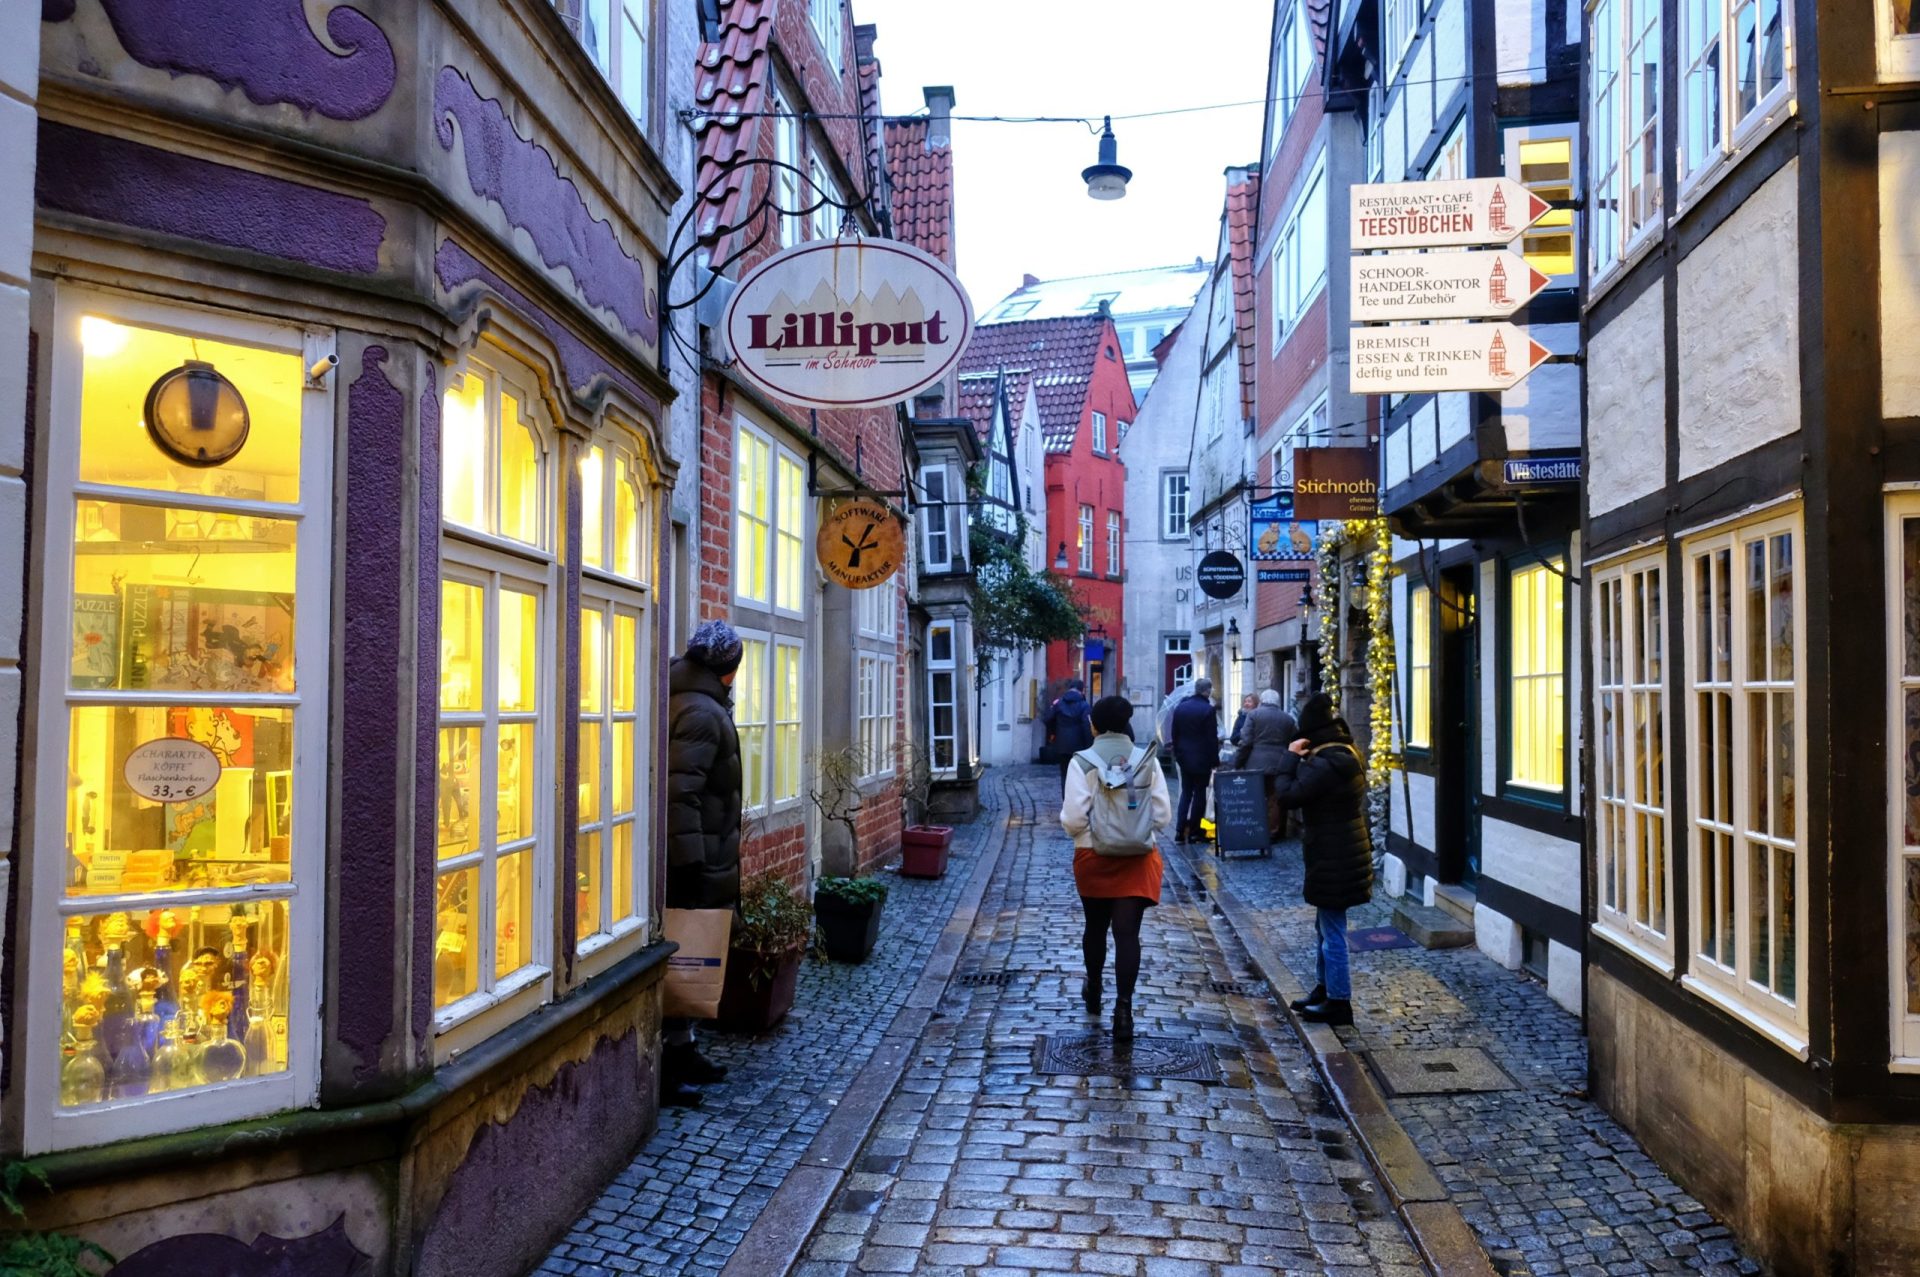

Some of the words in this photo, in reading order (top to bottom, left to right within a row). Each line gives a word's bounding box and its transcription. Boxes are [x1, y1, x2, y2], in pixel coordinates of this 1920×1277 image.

[1359, 195, 1434, 207] RESTAURANT
[1443, 192, 1473, 203] CAFÉ
[1372, 206, 1403, 216] WEIN
[1423, 204, 1460, 214] STUBE
[1359, 267, 1429, 279] SCHNOOR-
[1359, 278, 1481, 293] HANDELSKONTOR
[1359, 295, 1379, 306] Tee
[1383, 294, 1404, 305] und
[1407, 292, 1456, 304] Zubehör
[747, 310, 949, 356] Lilliput
[1357, 337, 1430, 349] BREMISCH
[805, 356, 819, 370] im
[823, 350, 879, 370] Schnoor
[1357, 352, 1400, 364] ESSEN
[1404, 352, 1414, 363] &
[1418, 349, 1482, 361] TRINKEN
[1356, 366, 1392, 380] deftig
[1396, 366, 1420, 377] und
[1423, 365, 1448, 376] fein
[1297, 479, 1375, 494] Stichnoth
[835, 507, 887, 524] SOFTWARE
[828, 561, 891, 583] MANUFAKTUR
[74, 598, 116, 612] PUZZLE
[132, 587, 148, 638] PUZZLE
